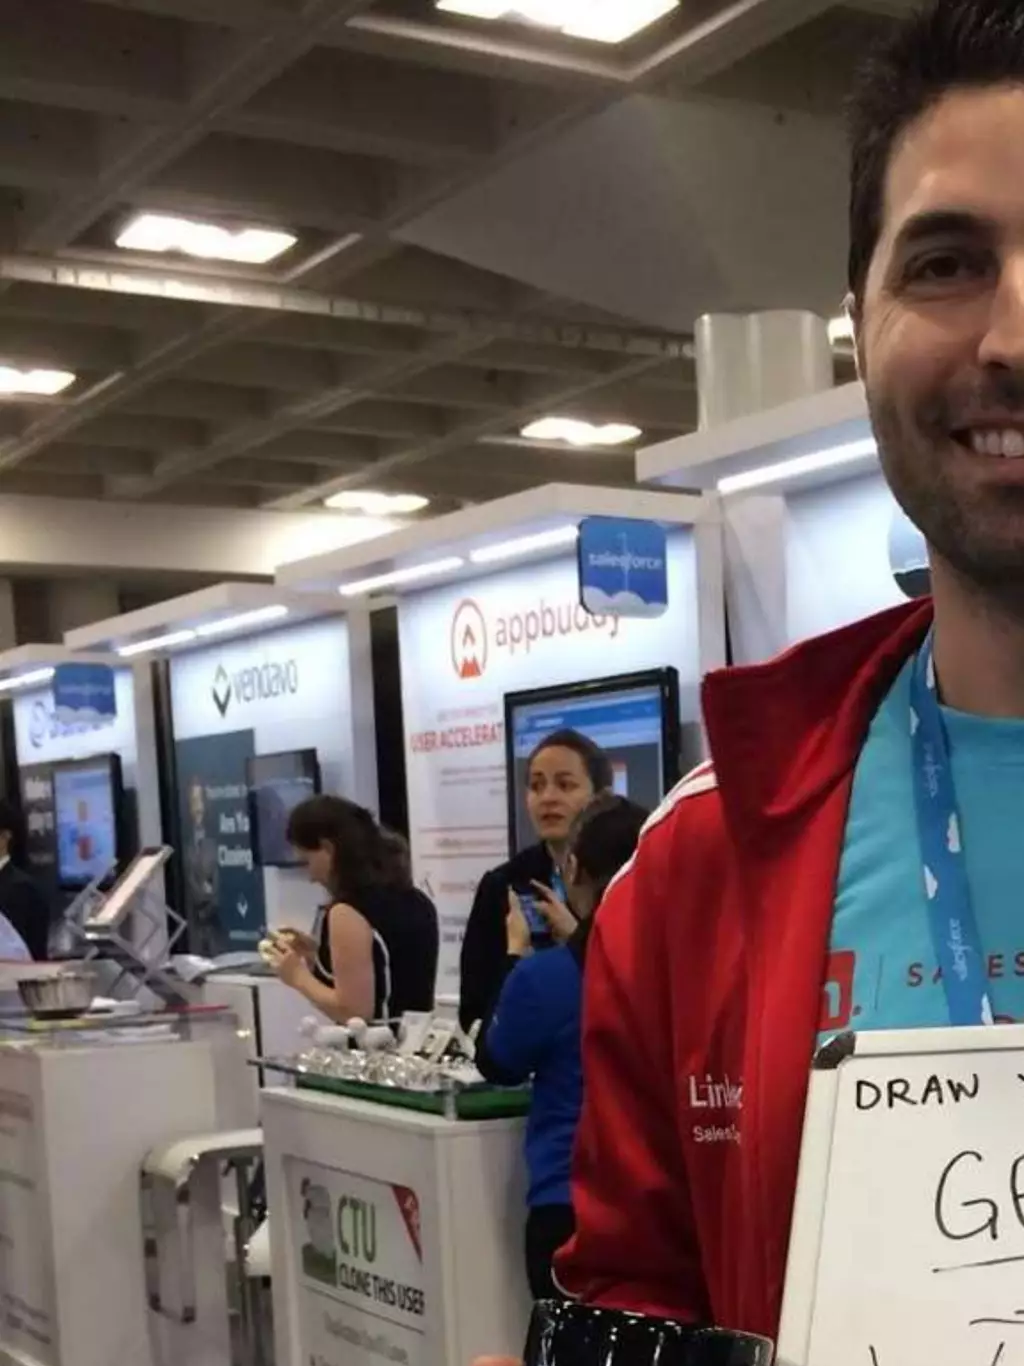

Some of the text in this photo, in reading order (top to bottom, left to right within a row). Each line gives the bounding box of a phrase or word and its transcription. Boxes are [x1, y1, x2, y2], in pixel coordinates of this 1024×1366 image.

[588, 551, 663, 570] salesforce
[855, 1072, 980, 1111] DRAW
[338, 1194, 376, 1263] CTU
[339, 1263, 425, 1315] CLONE THIS USER
